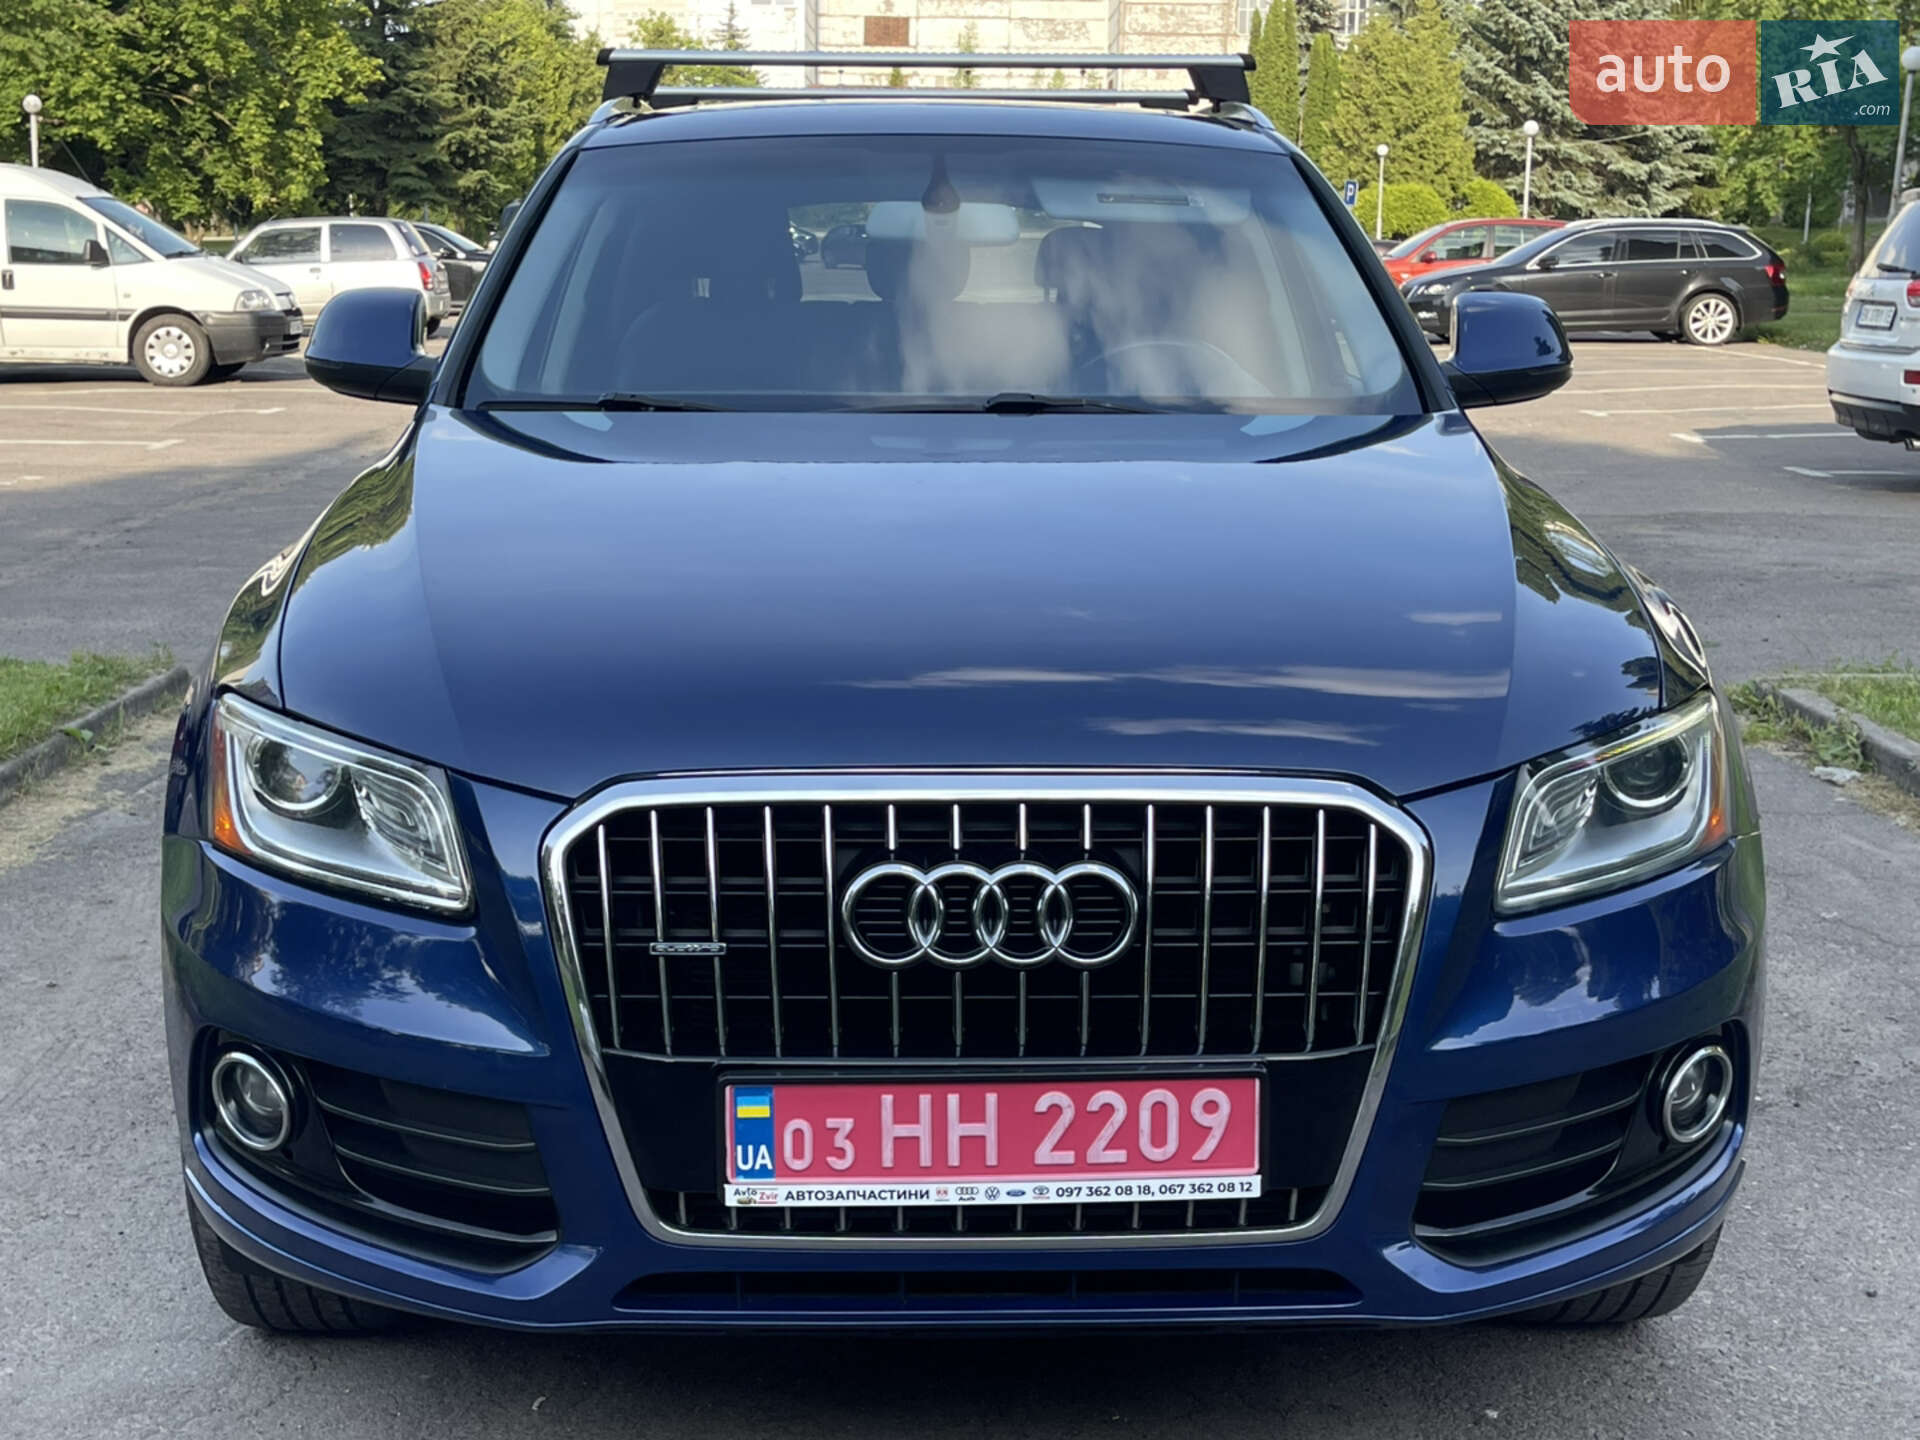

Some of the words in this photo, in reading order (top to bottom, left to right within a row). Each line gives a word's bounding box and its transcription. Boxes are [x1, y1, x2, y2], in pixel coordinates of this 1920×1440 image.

[1346, 183, 1355, 202] P
[783, 1118, 855, 1171] 03
[881, 1093, 998, 1168] HH
[1034, 1087, 1232, 1165] 2209
[736, 1145, 773, 1170] UA
[785, 1189, 930, 1201] АВТОЗАПЧАСТИНИ
[1055, 1186, 1083, 1198] 097
[1086, 1186, 1111, 1197] 362
[1115, 1185, 1134, 1196] 08
[1137, 1184, 1155, 1197] 18,
[1158, 1183, 1185, 1195] 067
[1188, 1182, 1214, 1194] 362
[1217, 1182, 1236, 1193] 08
[1239, 1181, 1253, 1193] 12
